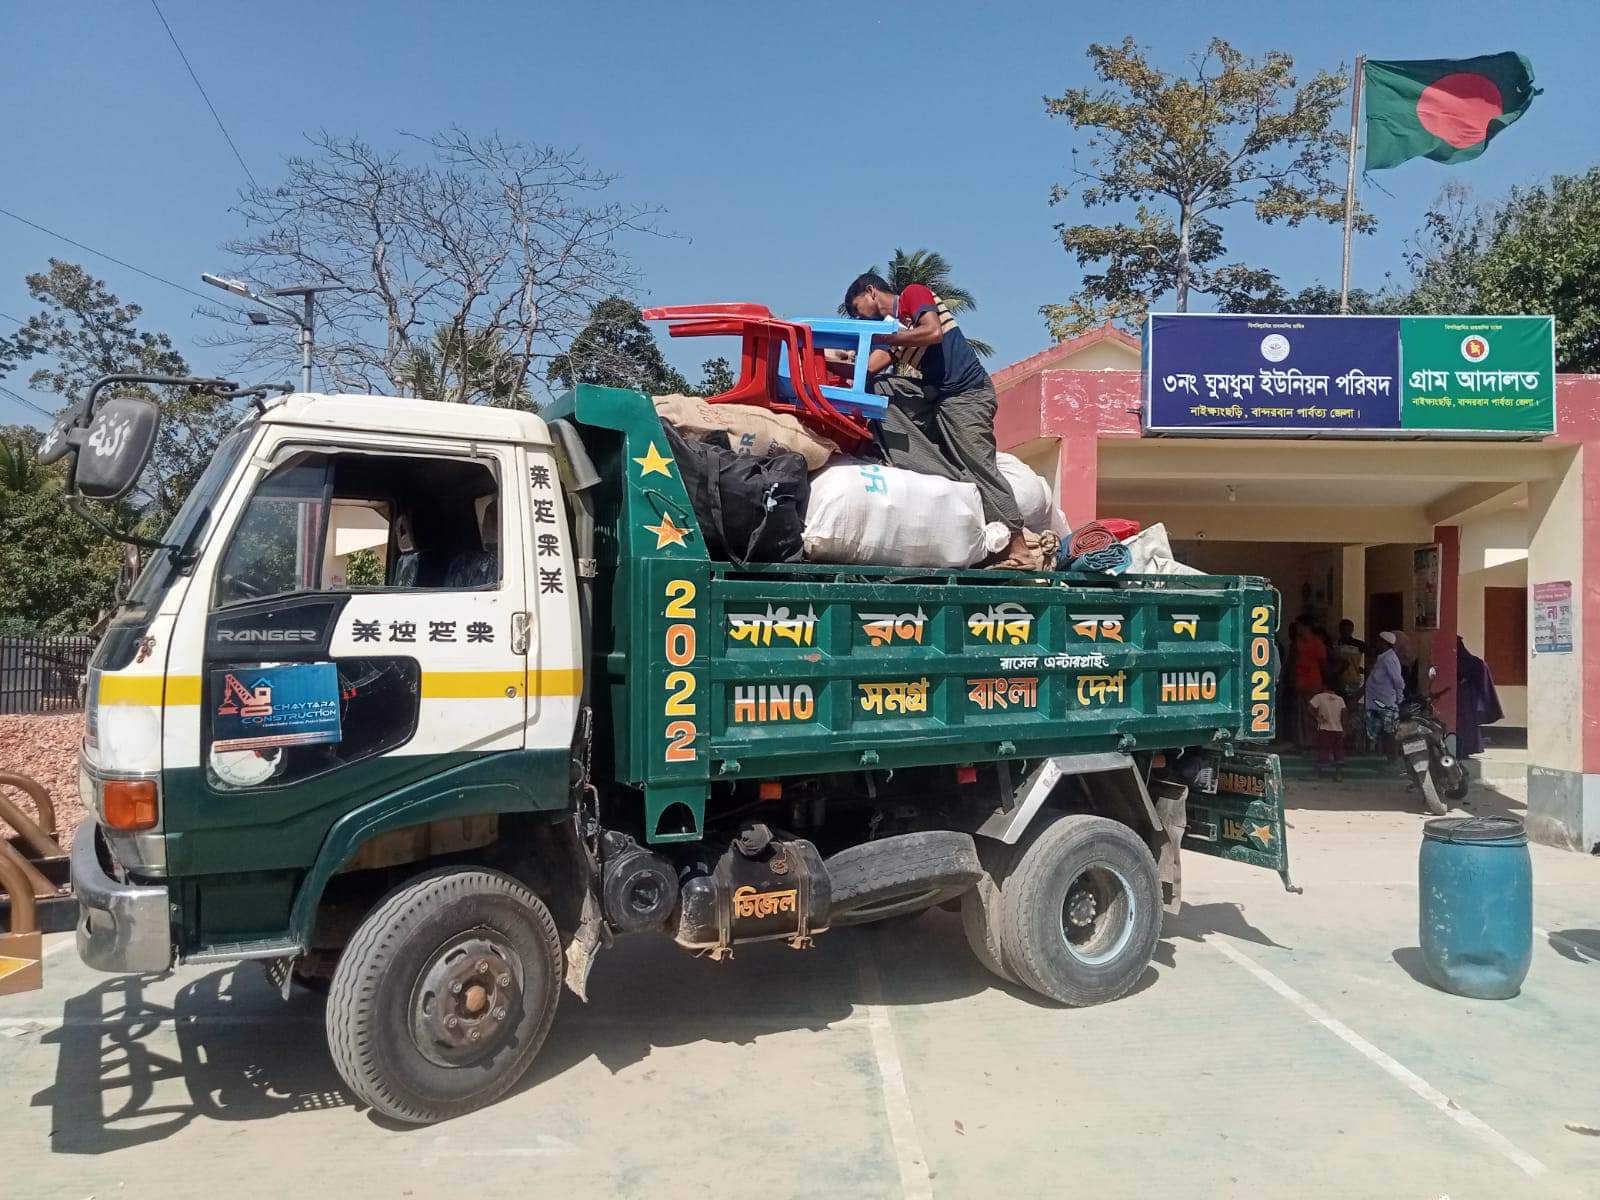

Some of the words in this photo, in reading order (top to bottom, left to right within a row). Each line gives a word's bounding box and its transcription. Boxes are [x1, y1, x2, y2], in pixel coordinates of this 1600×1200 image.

[1163, 373, 1199, 395] ৩নং
[1203, 374, 1254, 399] ঘুমধুম
[1259, 368, 1329, 396] ইউনিয়ন
[1335, 368, 1392, 396] পরিষদ
[1409, 369, 1450, 392] গ্রাম
[1454, 369, 1540, 392] আদালত
[1251, 407, 1293, 418] বান্দরবান
[1297, 406, 1326, 419] পার্বত্য
[217, 630, 317, 641] RANGER
[727, 602, 820, 647] সাধা
[857, 604, 929, 647] রণ
[967, 602, 1035, 645] পরি
[1069, 613, 1125, 644] বহ
[1171, 613, 1200, 640] ন
[665, 579, 697, 762] 2022
[1000, 655, 1039, 670] রাসেল
[1251, 606, 1270, 732] 2022
[273, 700, 336, 711] CHAYTARA
[734, 684, 814, 722] HINO
[858, 677, 930, 715] সমগ্র
[967, 677, 1039, 710] বাংলা
[1076, 670, 1127, 705] দেশ
[1161, 671, 1217, 702] HINO
[241, 709, 336, 725] CONSTRUCTION
[733, 886, 798, 918] ডিজেল
